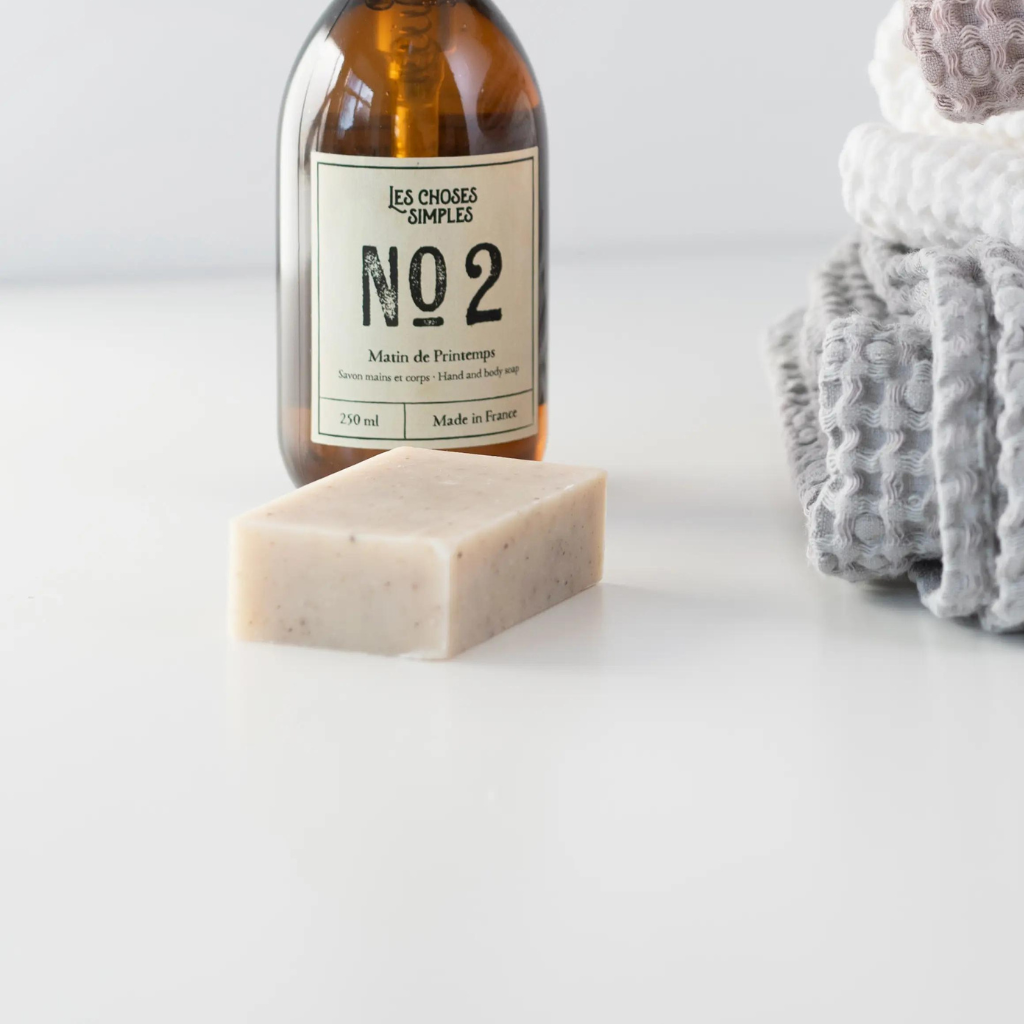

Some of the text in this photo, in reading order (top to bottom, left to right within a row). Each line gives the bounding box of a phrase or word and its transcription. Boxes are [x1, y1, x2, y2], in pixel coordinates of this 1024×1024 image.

[418, 186, 478, 205] CHOSES
[408, 206, 473, 225] SIMPLES
[465, 242, 503, 326] 2
[368, 349, 496, 363] Matin de Printemps
[338, 369, 363, 381] Savon
[365, 372, 392, 382] mains
[405, 375, 430, 385] corps
[438, 370, 464, 382] Hand
[466, 368, 482, 379] and
[484, 366, 503, 378] body
[504, 365, 520, 376] soap
[340, 412, 379, 427] 250 ml
[433, 409, 518, 427] Made in France
